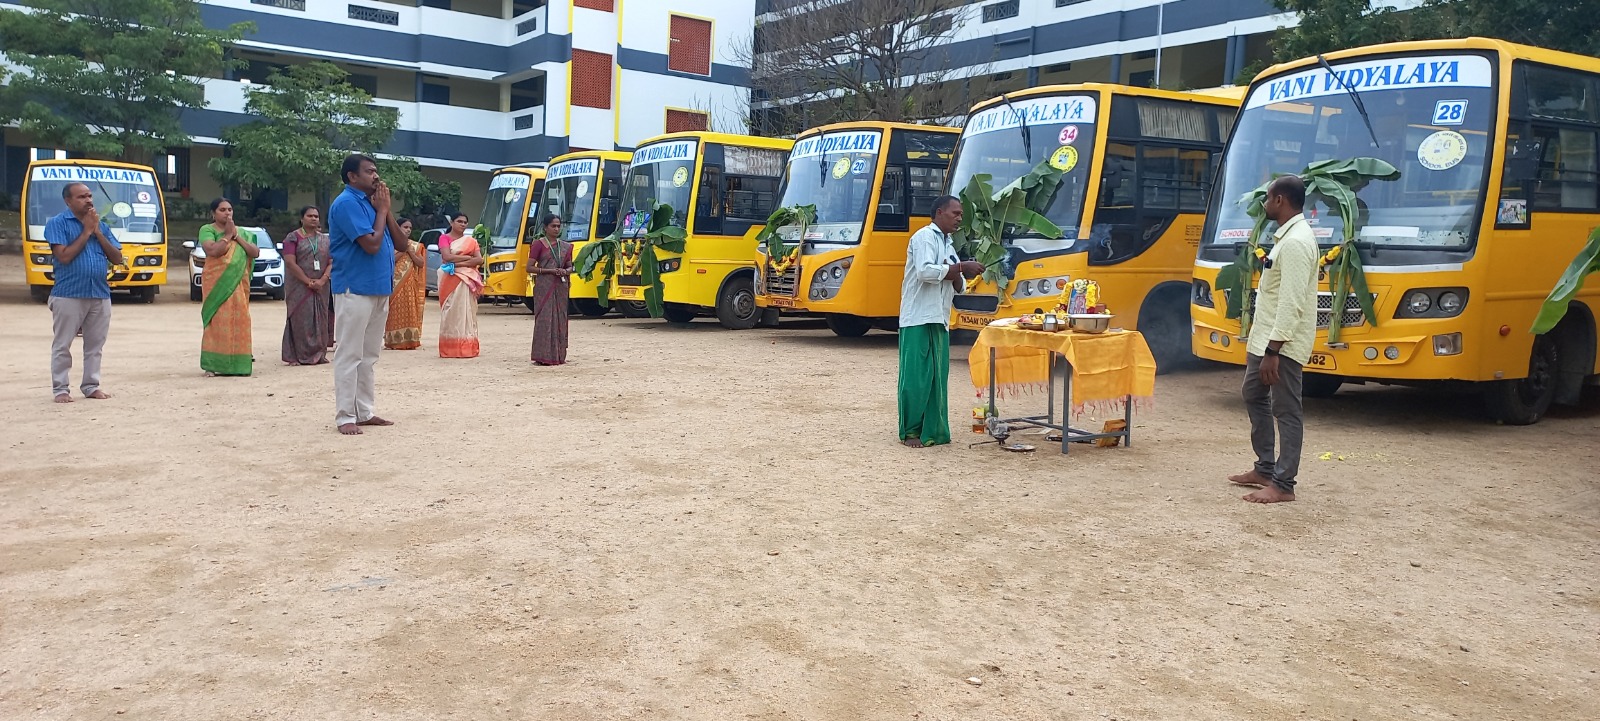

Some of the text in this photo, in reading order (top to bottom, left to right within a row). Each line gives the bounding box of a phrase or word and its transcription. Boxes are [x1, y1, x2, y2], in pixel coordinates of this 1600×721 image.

[1269, 61, 1460, 100] VANI VIDYALAYA
[971, 100, 1084, 133] VANI VIDYALAYA
[1437, 104, 1462, 120] 28
[1061, 128, 1075, 141] 34
[647, 144, 688, 160] VIDYALAYA
[792, 134, 876, 157] VANI VIDYALAYA
[559, 161, 592, 176] VIDYALAYA
[853, 161, 865, 171] 20
[41, 168, 144, 182] VANI VIDYALAYA
[1221, 229, 1245, 238] SCHOOL
